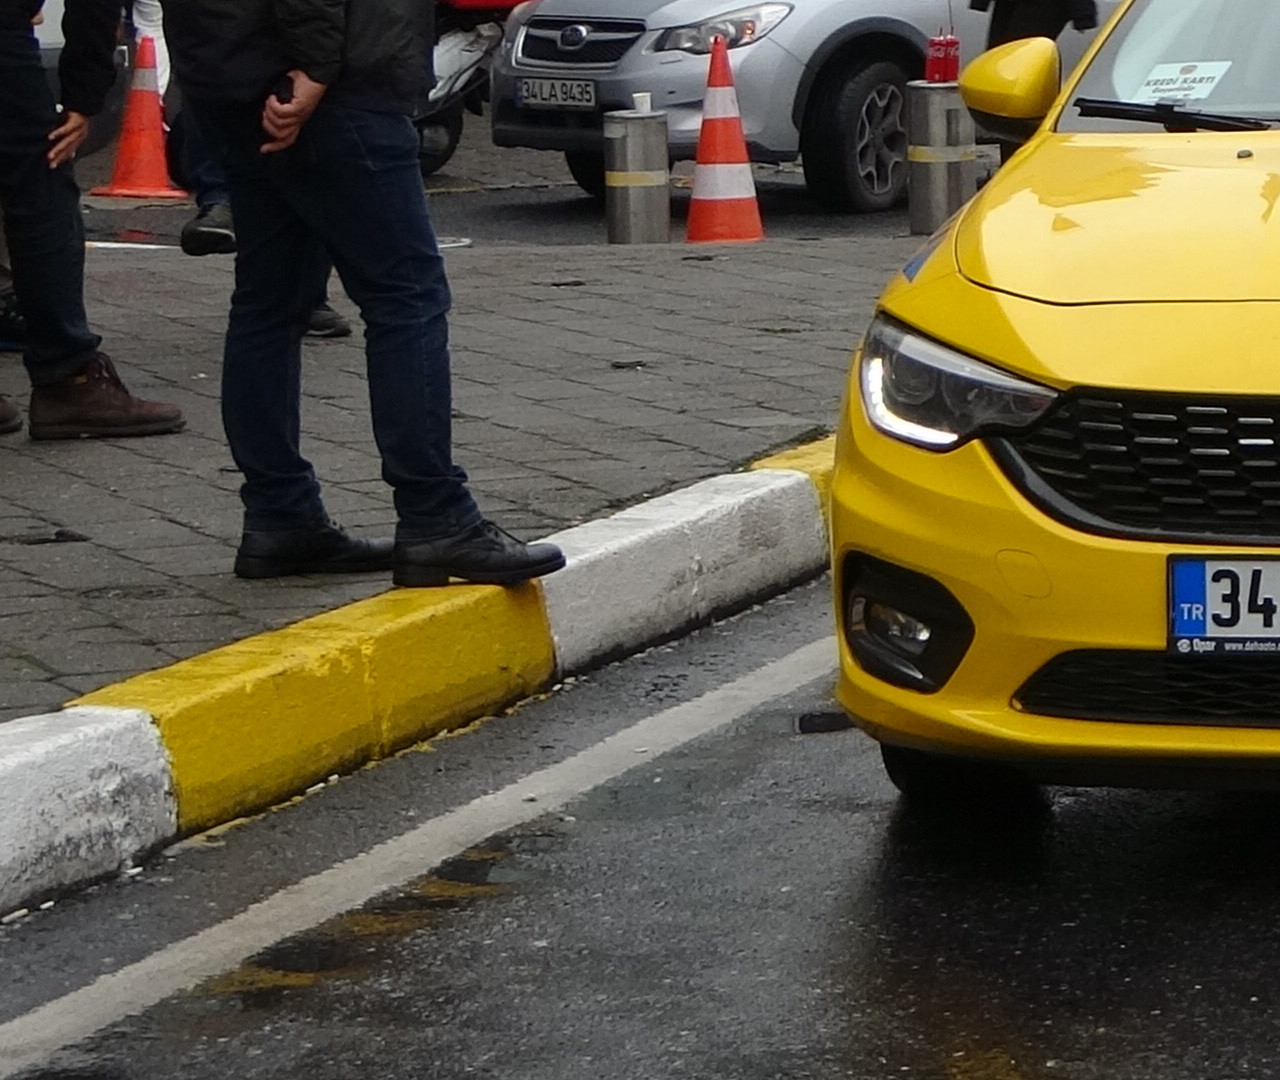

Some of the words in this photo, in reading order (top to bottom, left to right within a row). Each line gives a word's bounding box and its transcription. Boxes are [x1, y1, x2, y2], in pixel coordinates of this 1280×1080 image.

[523, 81, 538, 100] 34
[540, 82, 559, 102] LA
[561, 82, 593, 103] 9435
[1180, 604, 1204, 620] TR
[1211, 568, 1278, 628] 34
